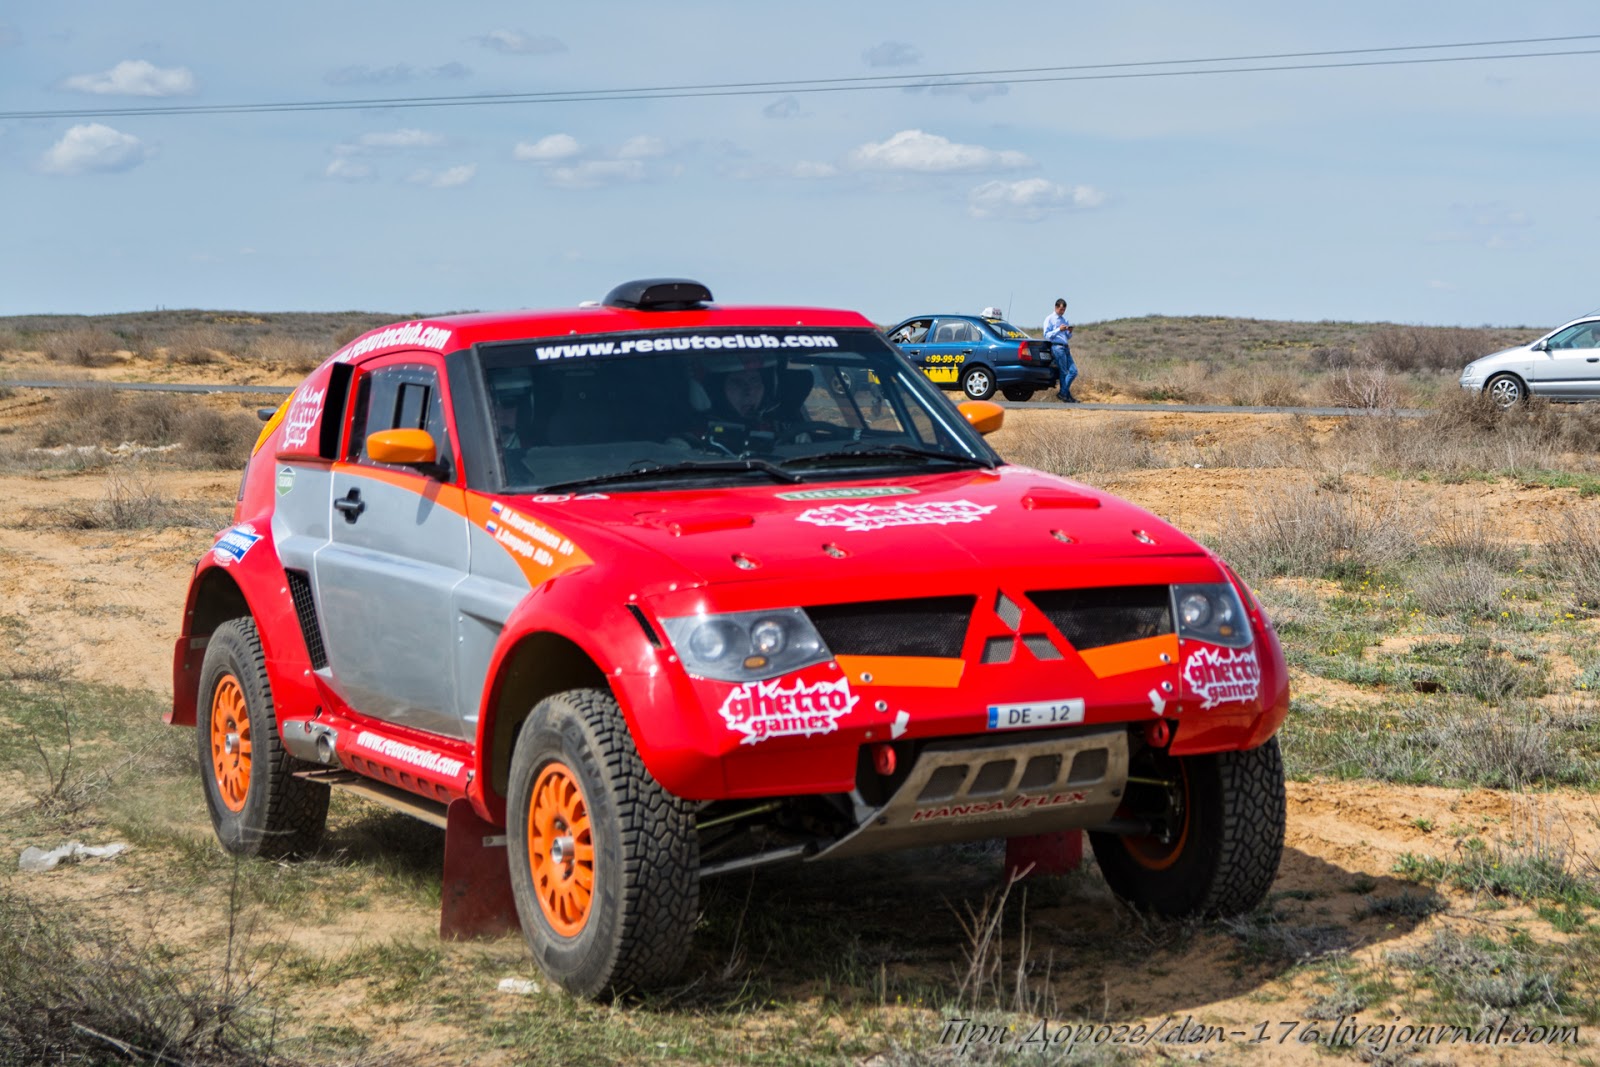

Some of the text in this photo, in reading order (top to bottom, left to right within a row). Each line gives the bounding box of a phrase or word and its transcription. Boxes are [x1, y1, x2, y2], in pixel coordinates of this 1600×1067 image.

[535, 334, 839, 361] www.reautoclub.com
[931, 354, 965, 363] 99-99-99
[1189, 653, 1259, 691] ghetto
[728, 682, 848, 724] ghetto
[1207, 683, 1256, 703] games
[750, 715, 832, 738] games
[1008, 707, 1032, 725] DE
[1050, 704, 1071, 722] 12
[357, 730, 465, 778] www.reautoclub.com
